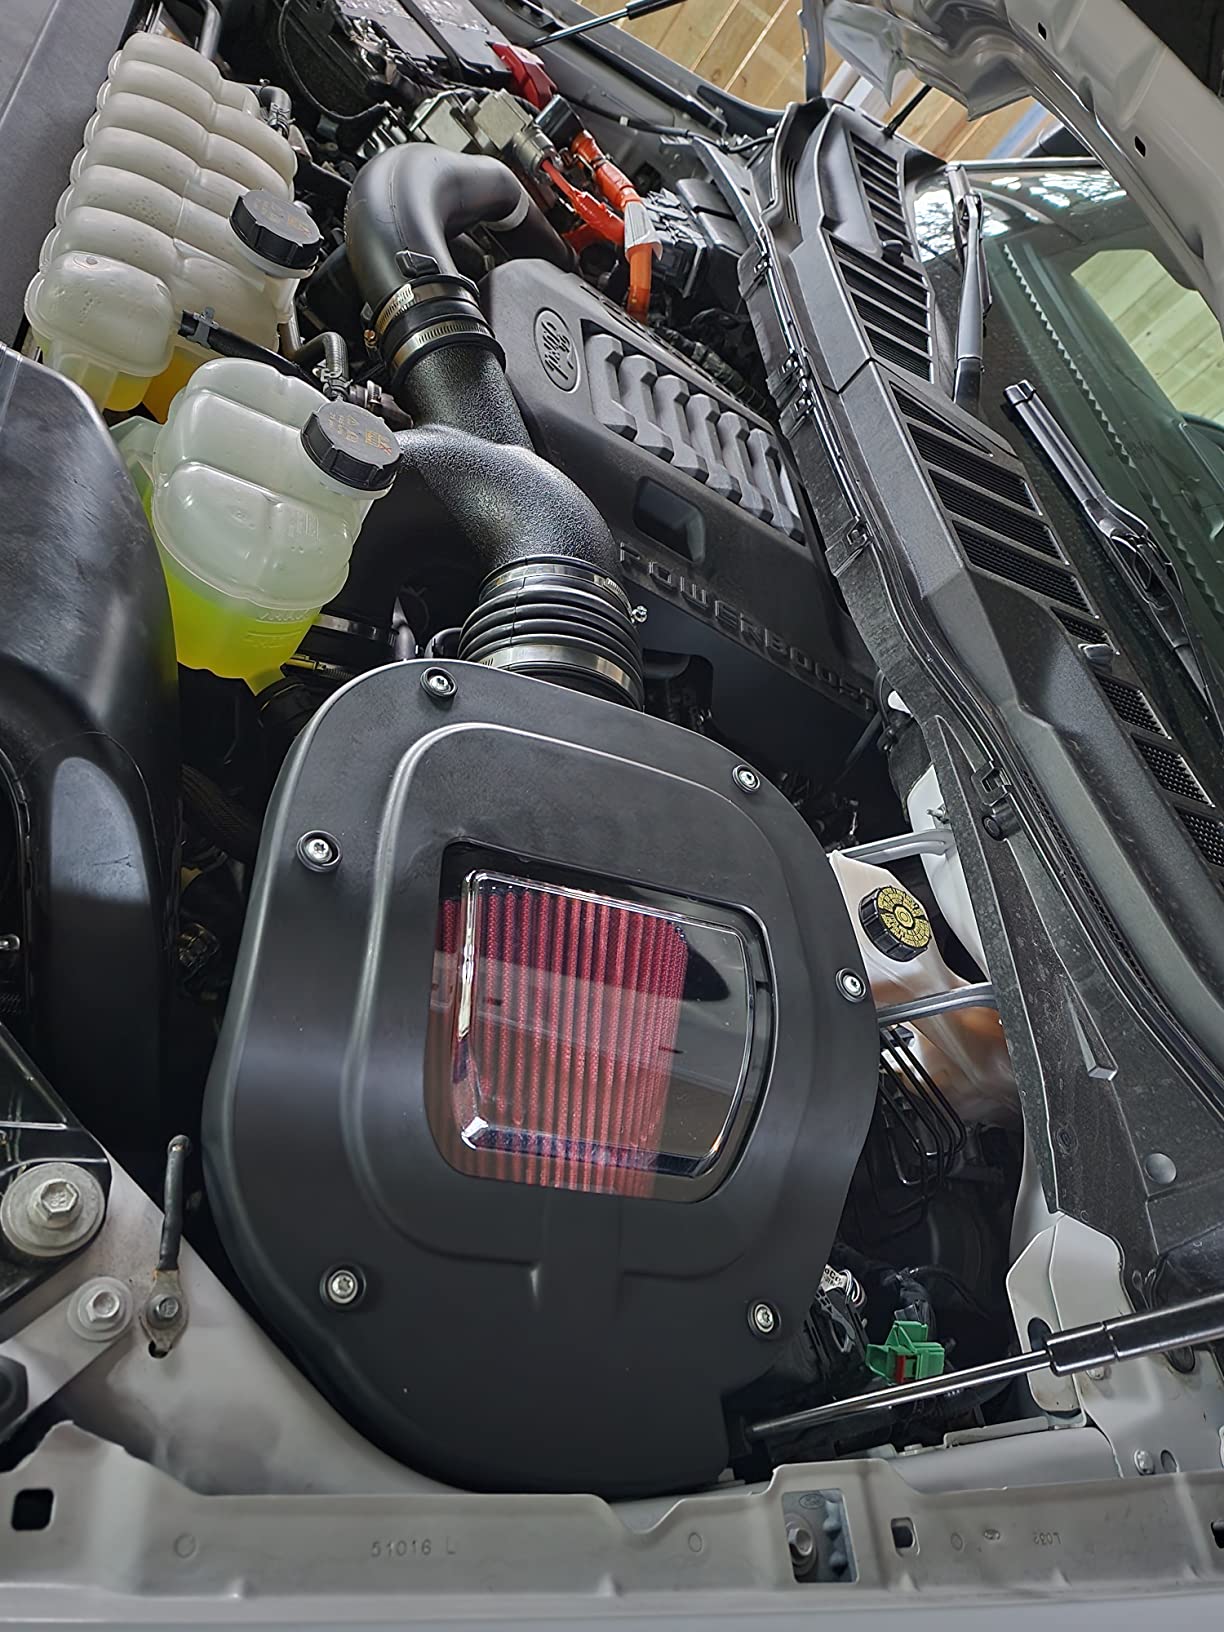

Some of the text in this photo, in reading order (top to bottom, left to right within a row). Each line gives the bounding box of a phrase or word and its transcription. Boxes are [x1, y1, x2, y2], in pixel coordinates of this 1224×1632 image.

[539, 317, 577, 384] Ford
[619, 541, 877, 711] POWERBOOST
[371, 1538, 432, 1557] 51016
